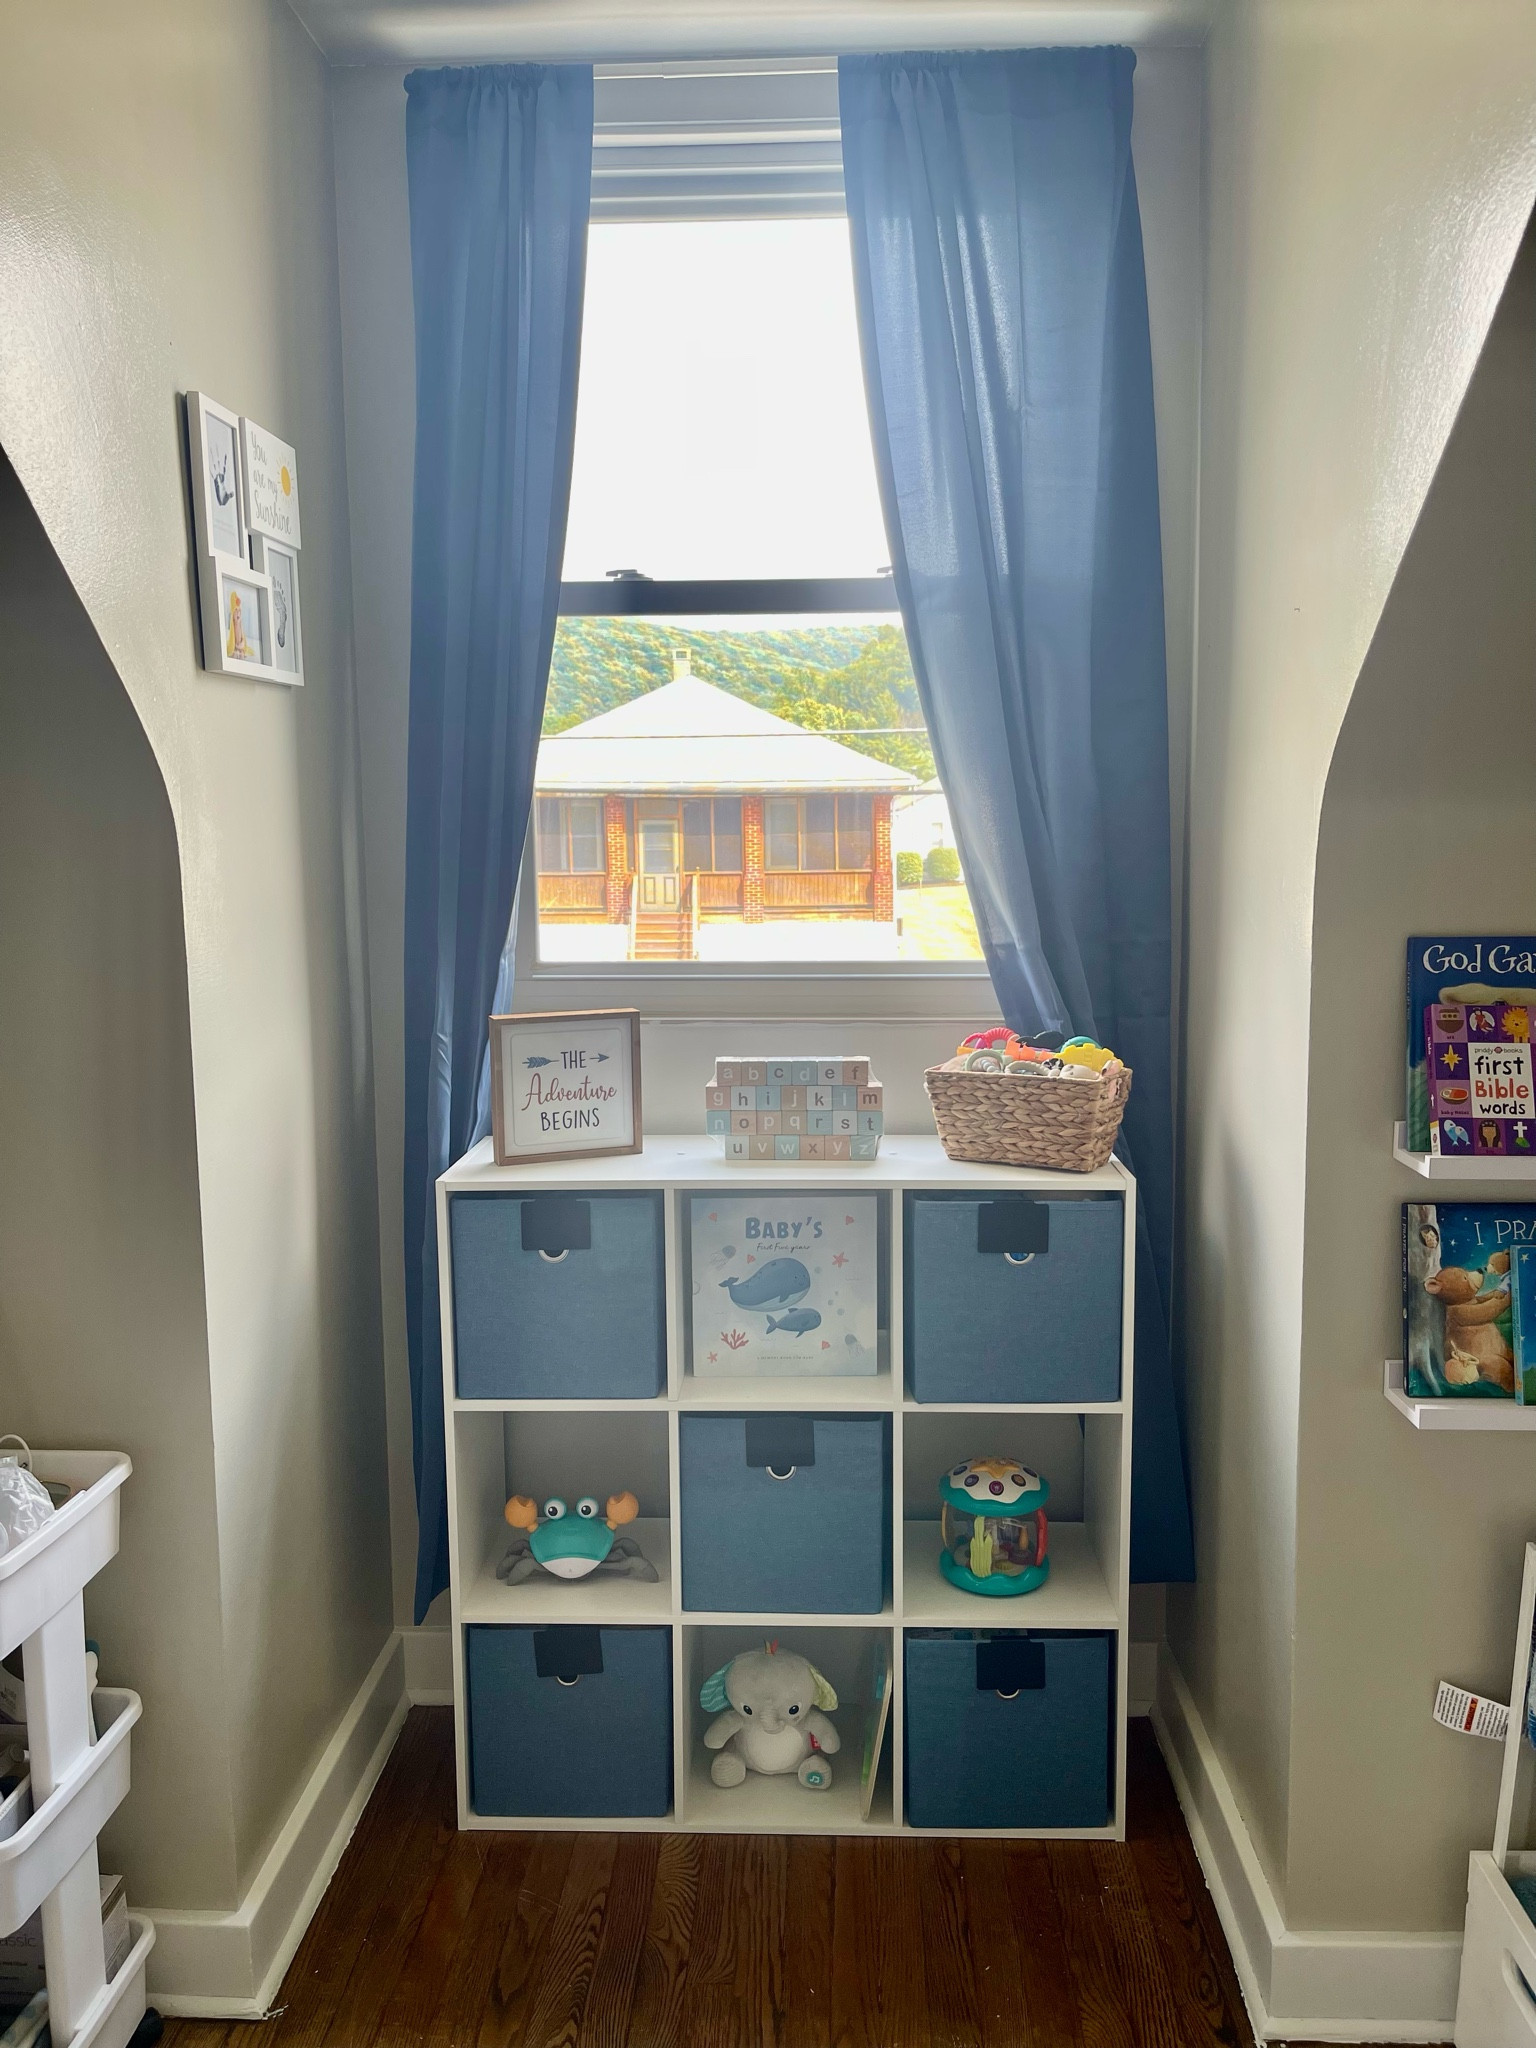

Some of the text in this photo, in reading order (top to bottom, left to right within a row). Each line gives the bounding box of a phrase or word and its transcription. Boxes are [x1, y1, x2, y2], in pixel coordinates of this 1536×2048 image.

[251, 431, 267, 466] You
[253, 469, 278, 502] are my
[254, 489, 292, 535] Sunshine
[1422, 944, 1536, 974] God Ga
[560, 1050, 587, 1070] THE
[1474, 1056, 1525, 1075] first
[521, 1072, 618, 1111] Adventure
[1474, 1077, 1530, 1099] Bible
[540, 1107, 600, 1132] BEGINS
[1479, 1100, 1527, 1115] words
[745, 1217, 823, 1239] BABY'S
[1474, 1221, 1484, 1246] I
